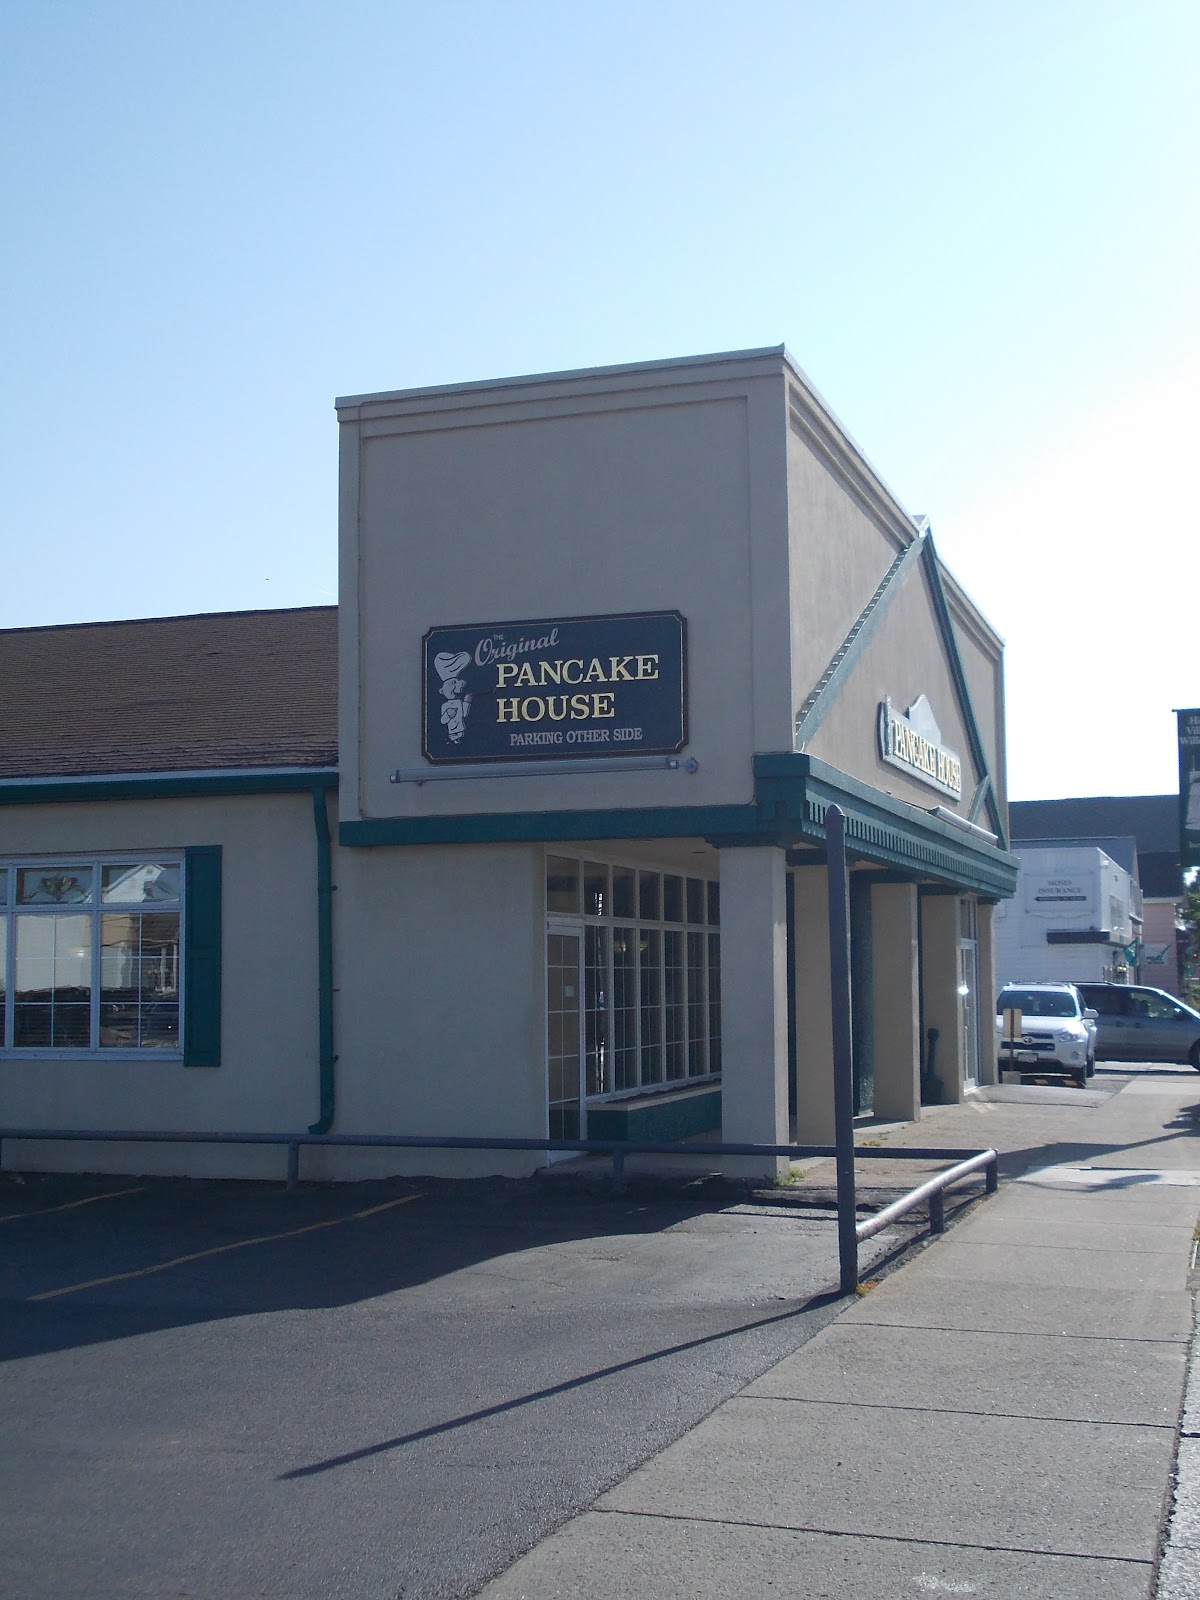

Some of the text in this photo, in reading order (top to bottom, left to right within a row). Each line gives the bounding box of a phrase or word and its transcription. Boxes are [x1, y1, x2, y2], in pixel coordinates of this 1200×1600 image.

[474, 627, 560, 667] Original
[496, 653, 659, 688] PANCAKE
[496, 692, 615, 723] HOUSE
[509, 727, 643, 746] PARKING OTHER SIDE
[893, 719, 961, 793] PANCAKE HOUSE
